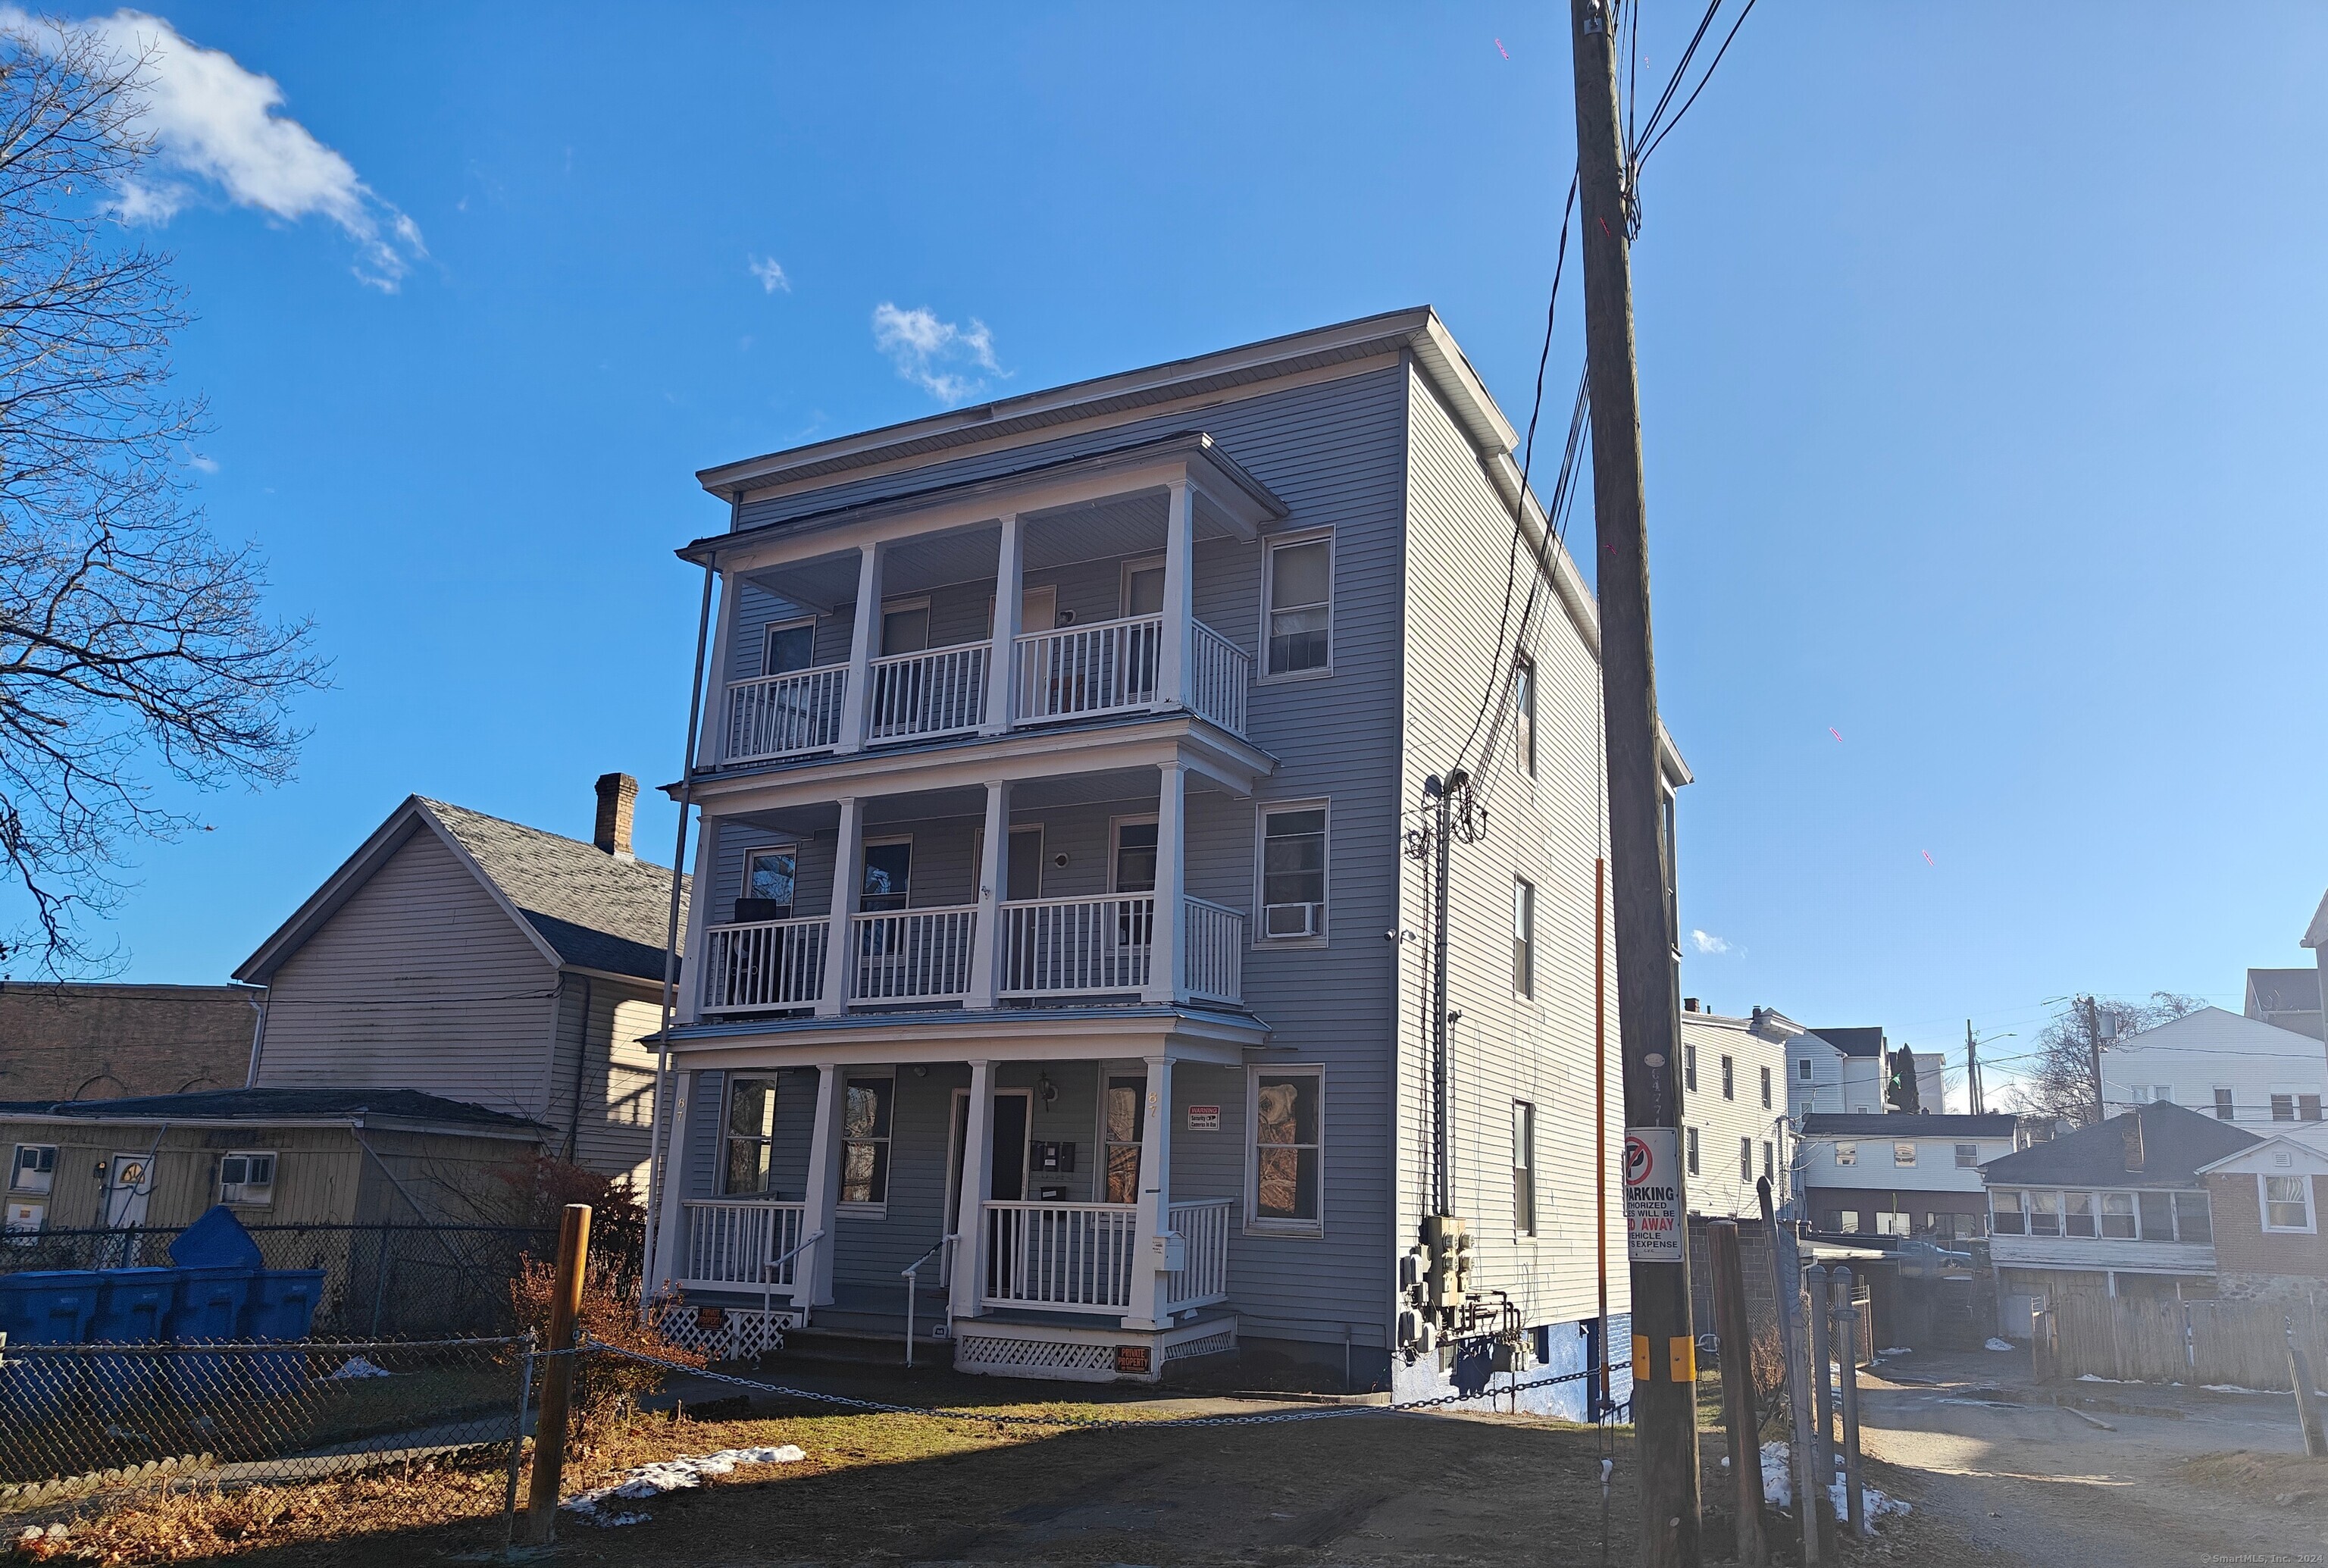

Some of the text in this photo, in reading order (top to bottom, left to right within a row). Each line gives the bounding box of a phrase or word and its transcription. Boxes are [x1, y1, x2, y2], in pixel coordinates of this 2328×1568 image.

[677, 1097, 685, 1122] 87
[1641, 1218, 1673, 1230] AWAY
[1122, 1347, 1145, 1357] PRIVATE
[1118, 1357, 1148, 1367] PROPERTY
